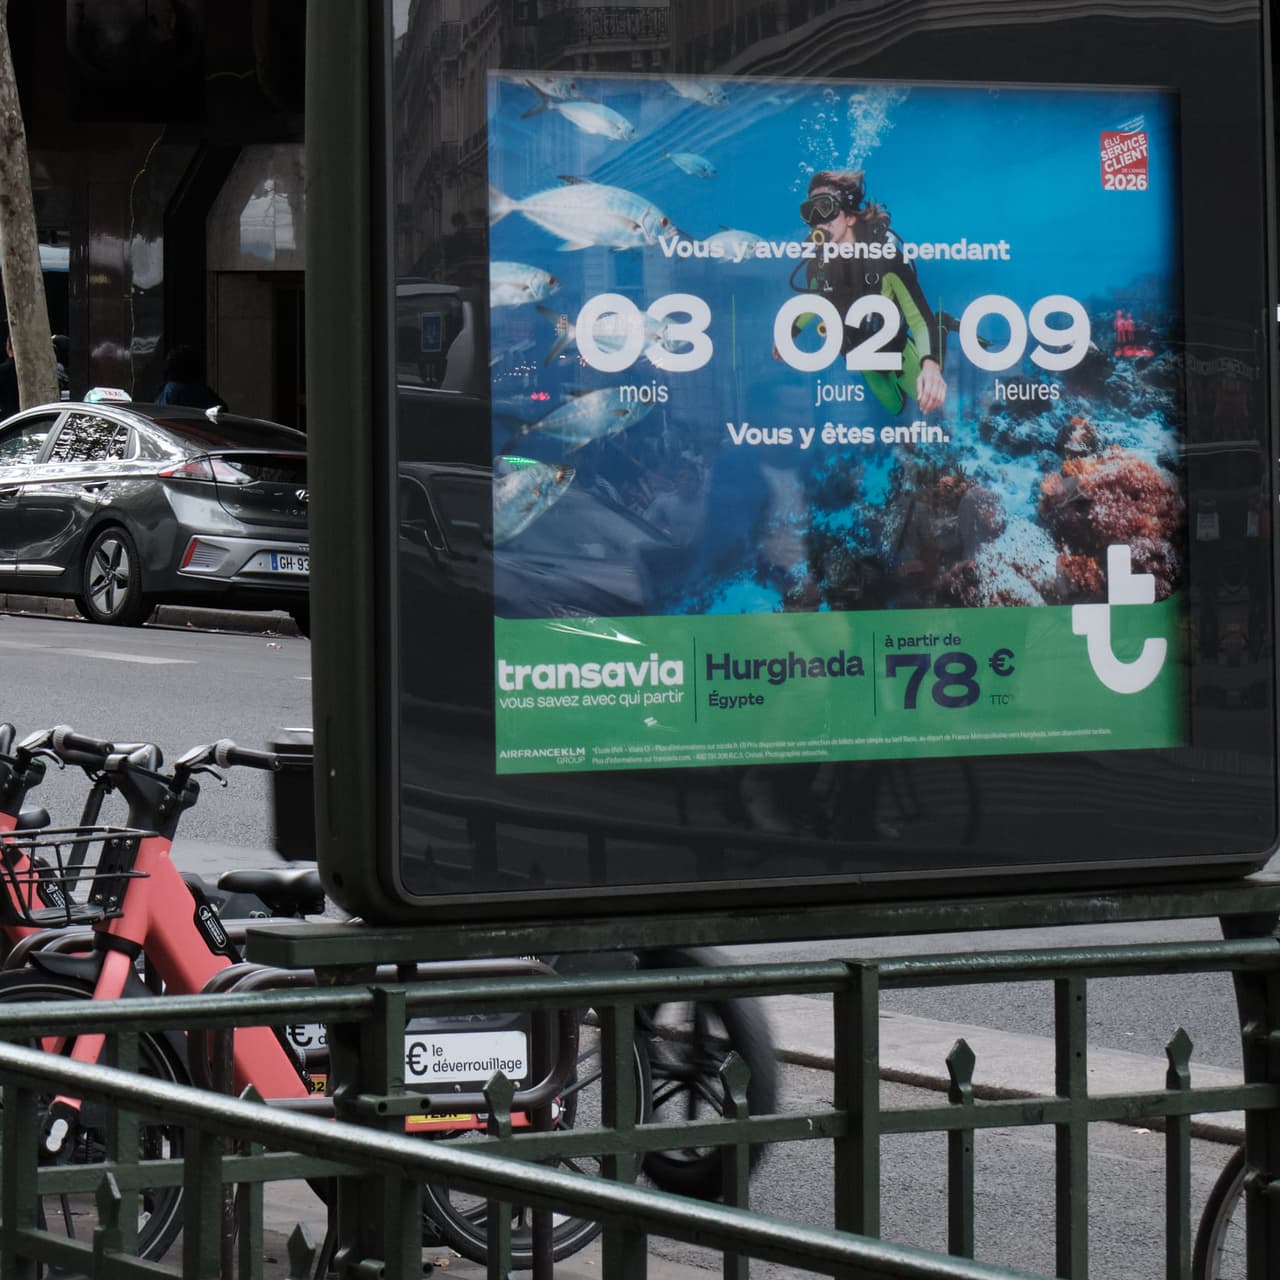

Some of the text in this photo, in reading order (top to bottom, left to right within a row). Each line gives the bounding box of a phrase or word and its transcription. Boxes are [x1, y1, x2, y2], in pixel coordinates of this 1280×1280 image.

[1101, 134, 1146, 161] SERVICE
[1104, 136, 1121, 148] ÉLU
[1104, 145, 1148, 173] CLIENT
[1104, 174, 1148, 191] 2026
[658, 232, 1011, 264] Vous y avez pensé pendant
[575, 293, 1092, 372] 03 02 09
[619, 378, 1060, 407] mois jours heures
[728, 417, 951, 451] Vous y êtes enfin.
[884, 632, 962, 650] à partir de
[497, 653, 684, 691] transavia
[705, 651, 865, 685] Hurghada
[884, 648, 1015, 710] 78 €
[499, 689, 684, 708] vous savez avec qui partir
[708, 690, 765, 708] Égypte
[556, 756, 586, 765] GROUP
[406, 1041, 444, 1076] € le
[432, 1057, 523, 1074] déverrouillage
